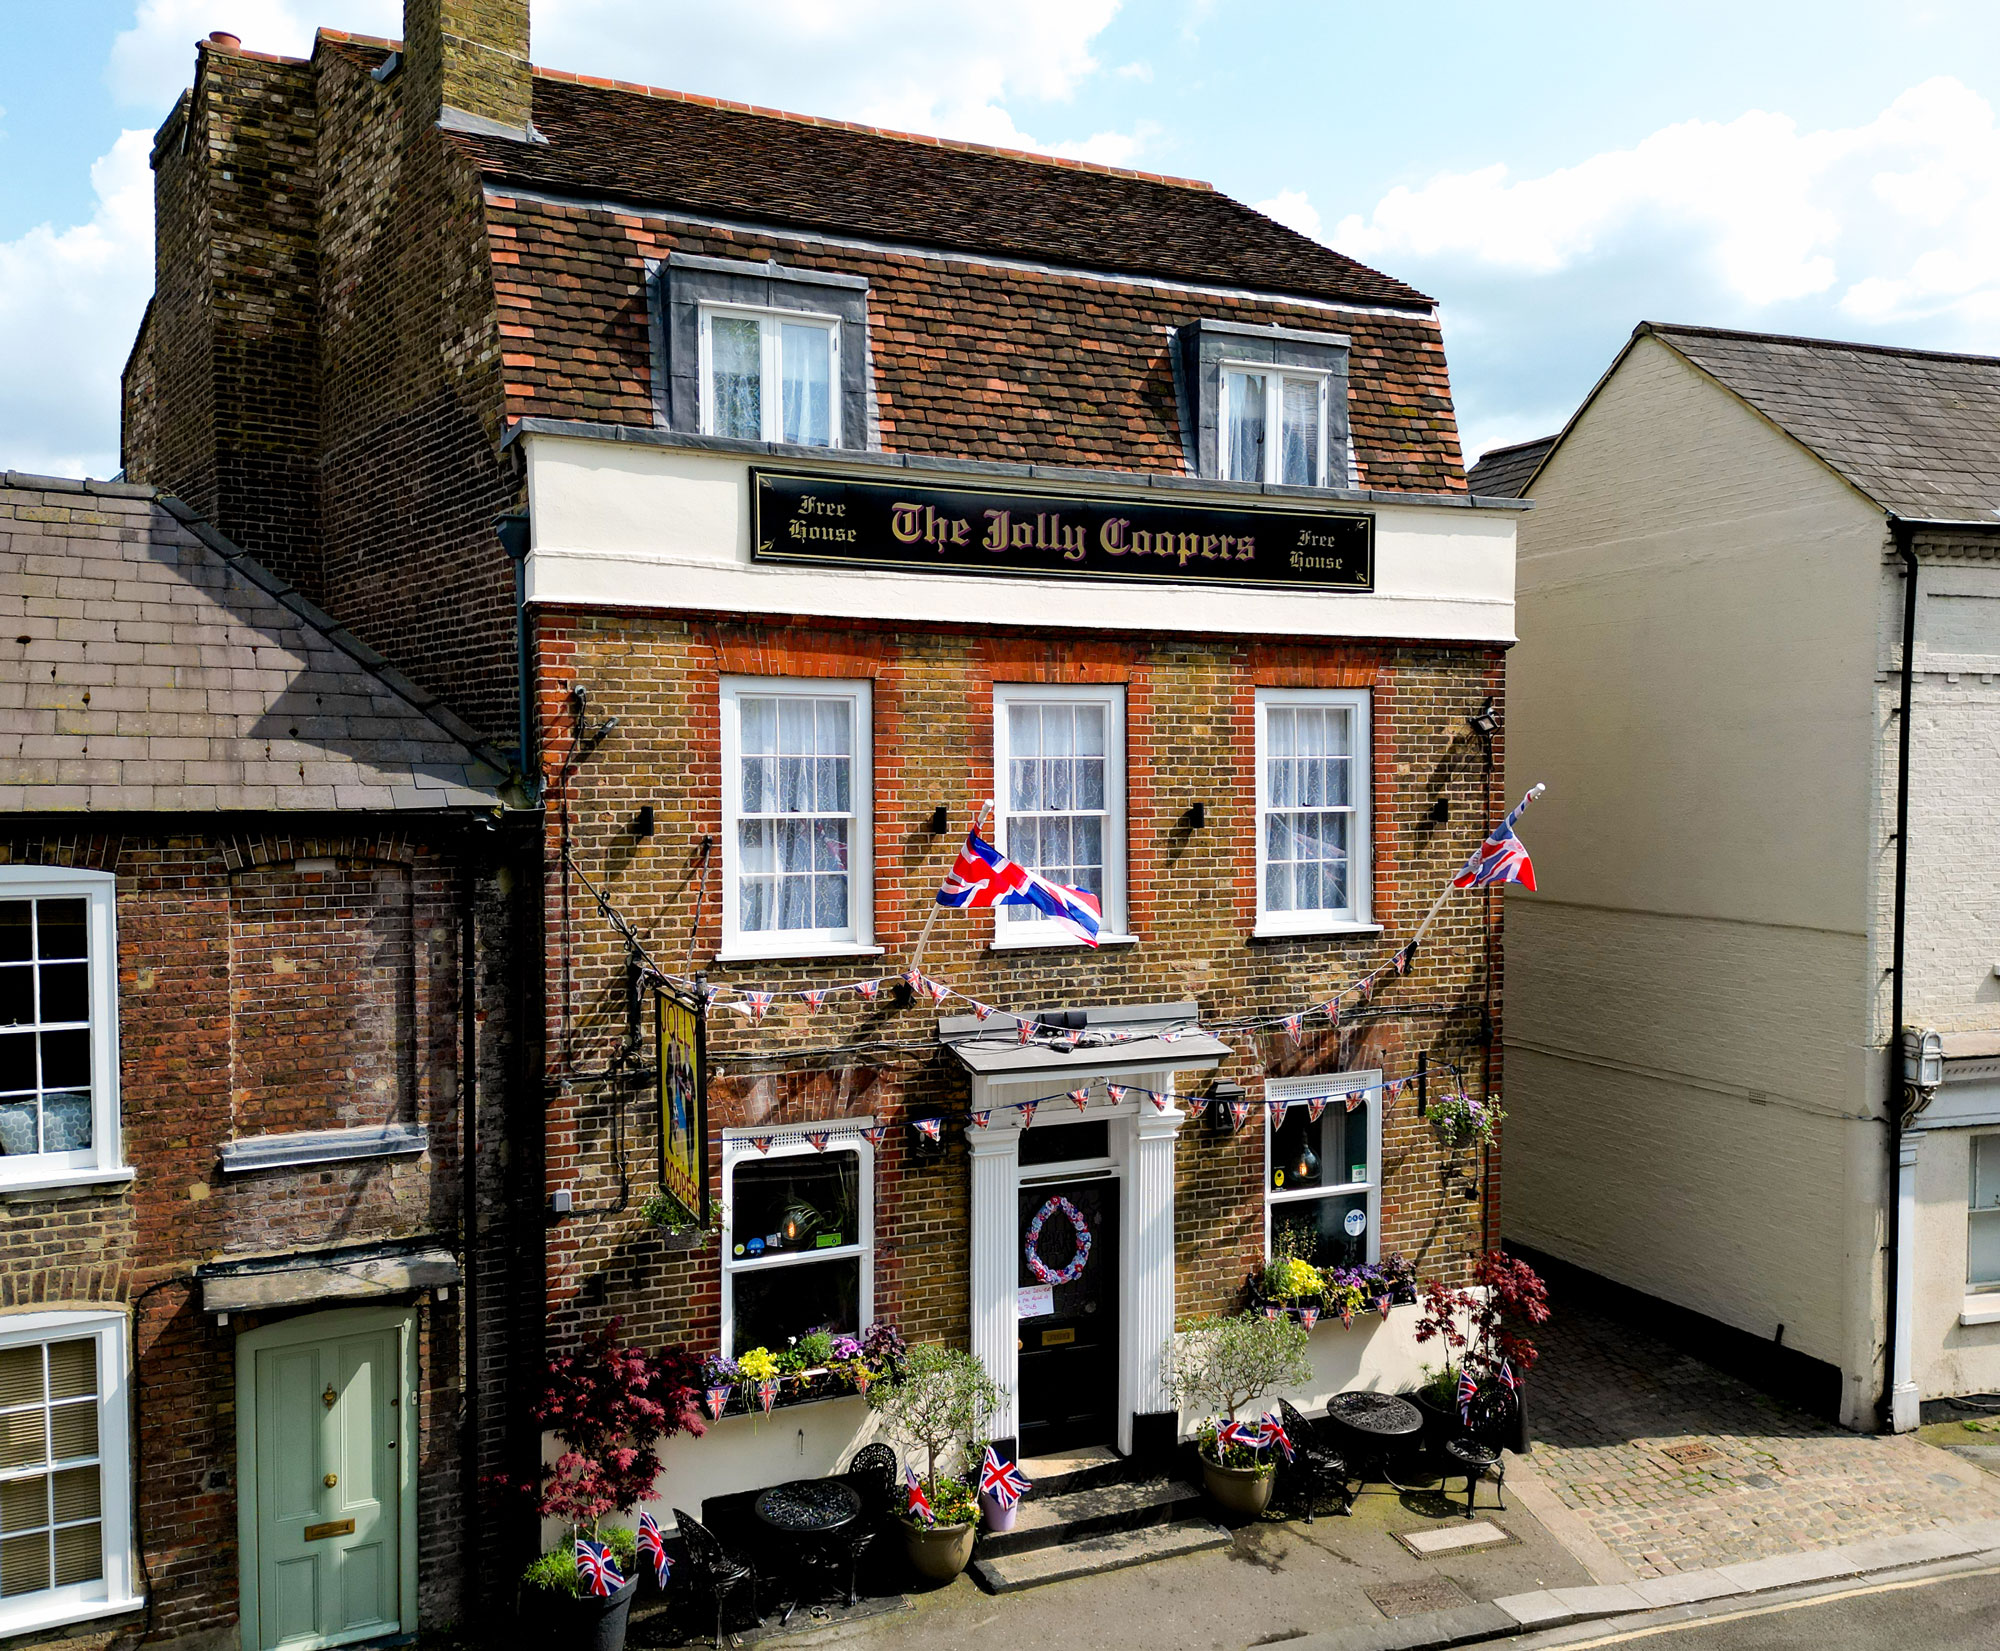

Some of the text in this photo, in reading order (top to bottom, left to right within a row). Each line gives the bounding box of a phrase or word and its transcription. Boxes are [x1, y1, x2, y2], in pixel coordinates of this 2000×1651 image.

[797, 494, 847, 518] Free
[788, 519, 857, 544] House
[891, 502, 1256, 568] The Jolly Coopers
[1296, 529, 1337, 549] Free
[1289, 550, 1344, 573] House
[661, 1001, 696, 1052] JOLLY
